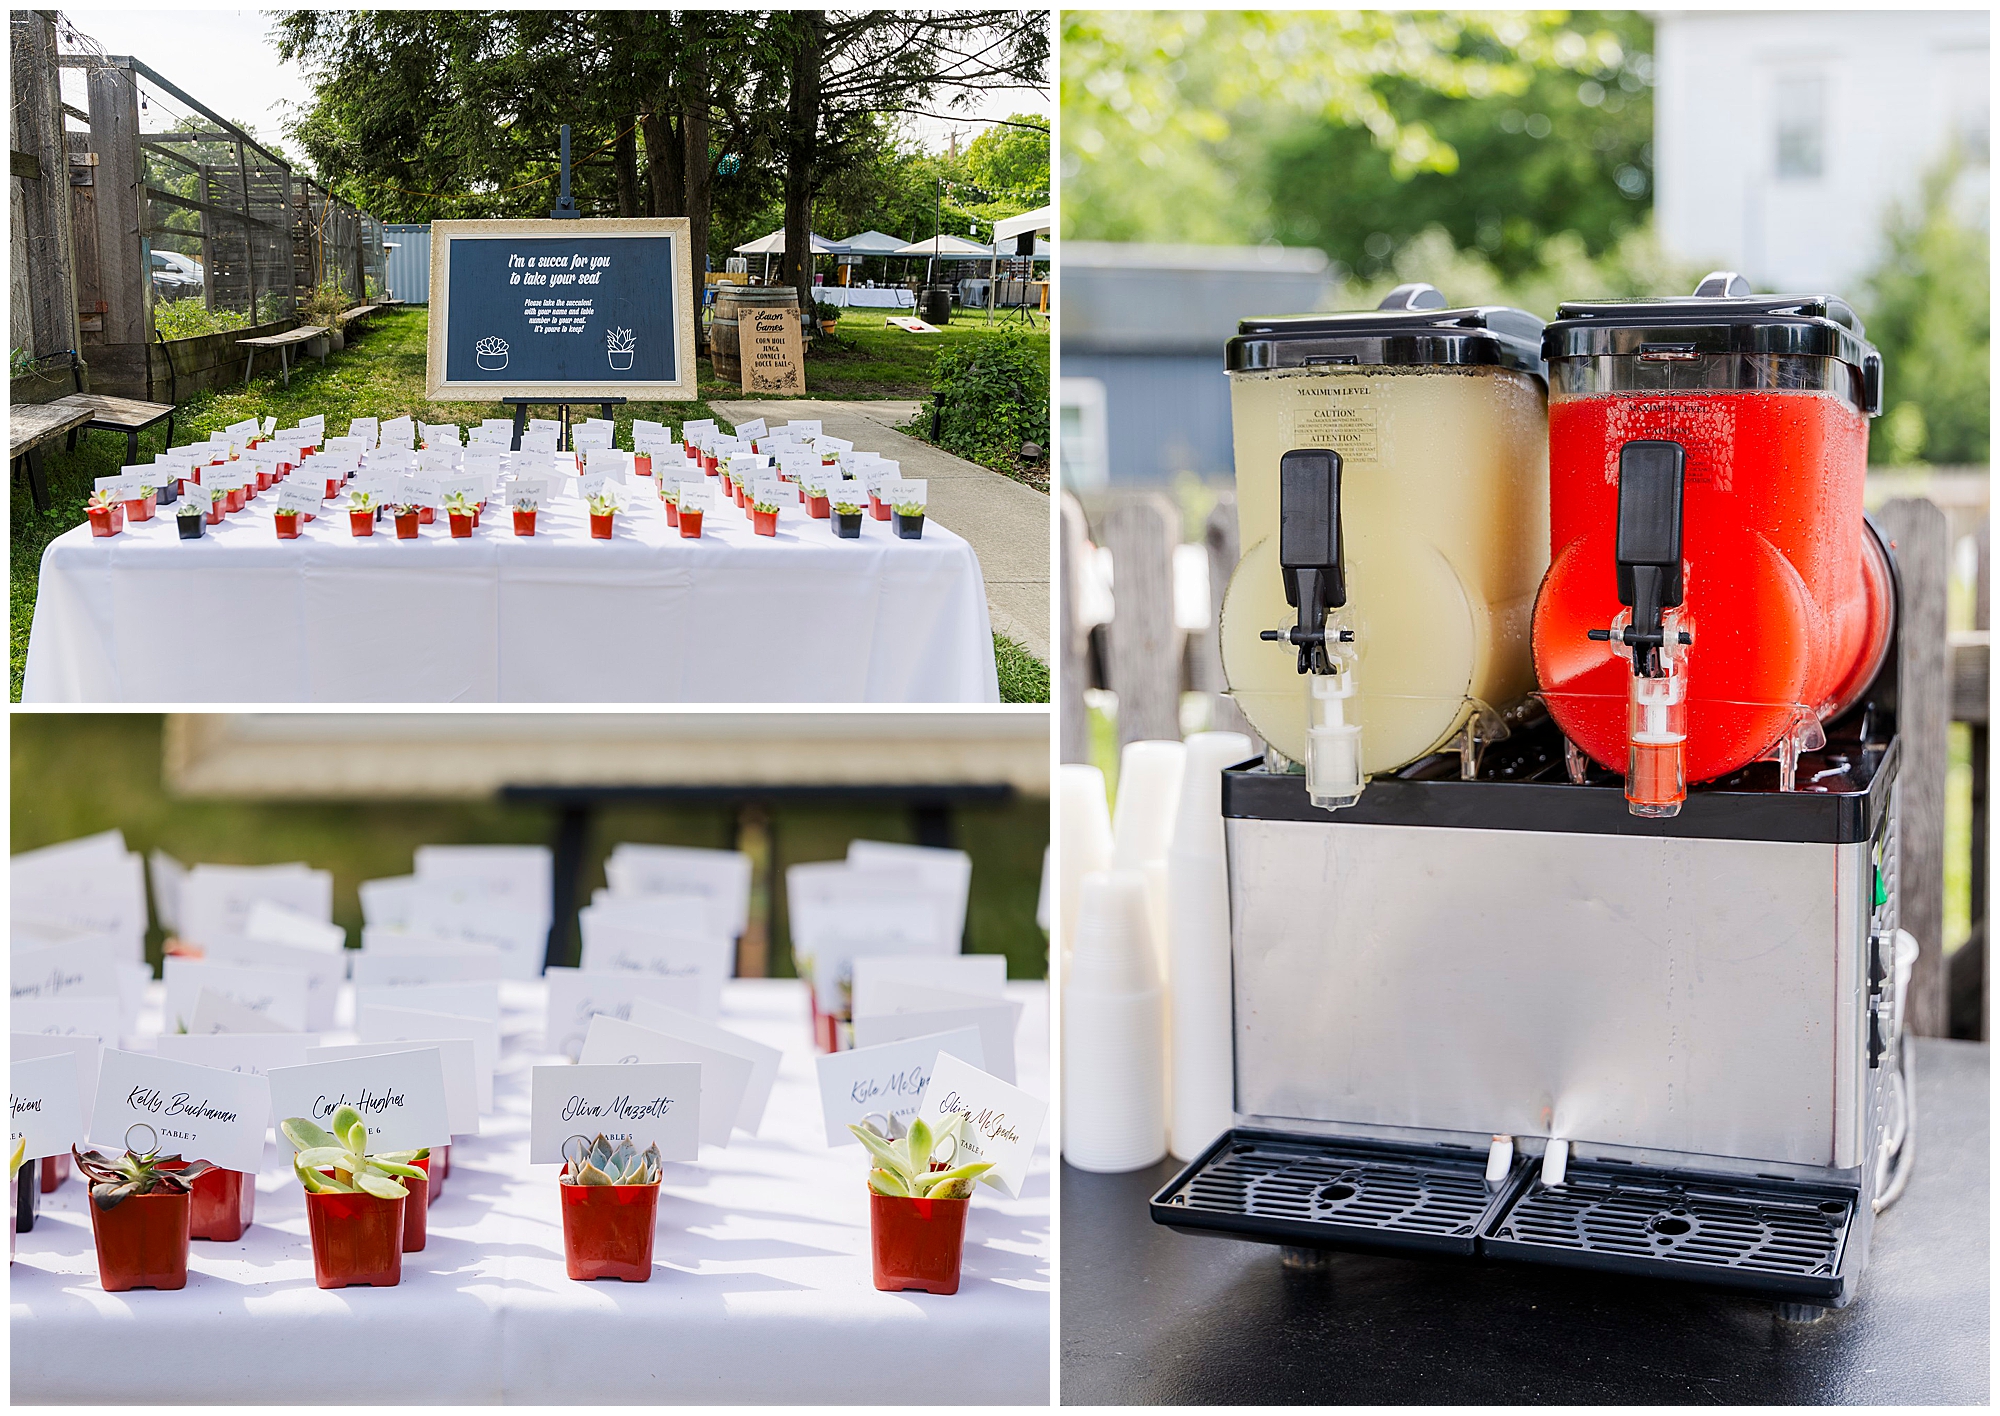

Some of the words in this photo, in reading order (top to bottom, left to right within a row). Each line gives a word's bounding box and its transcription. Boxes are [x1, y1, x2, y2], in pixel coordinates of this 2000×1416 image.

[508, 253, 525, 268] I'm
[528, 257, 536, 268] a
[538, 256, 568, 268] succa
[570, 253, 588, 270] for
[590, 256, 611, 270] you
[510, 271, 521, 285] to
[523, 271, 547, 285] take
[549, 273, 577, 288] your
[578, 271, 602, 285] seat
[524, 298, 542, 306] Please
[543, 298, 555, 306] take
[556, 298, 565, 306] the
[566, 298, 593, 306] succulent
[524, 307, 537, 315] with
[537, 308, 551, 317] your
[569, 307, 580, 315] and
[580, 307, 595, 315] table
[755, 310, 783, 320] Lawn
[529, 316, 551, 324] number
[551, 316, 558, 324] to
[558, 317, 573, 326] your
[561, 325, 568, 333] to
[568, 325, 585, 335] keep!
[756, 321, 784, 332] Games
[1297, 388, 1342, 396] MAXIMUM
[1343, 387, 1371, 395] LEVEL
[1314, 409, 1356, 418] CAUTION!
[1678, 405, 1707, 413] LEVEL
[1311, 434, 1361, 442] ATTENTION!
[851, 1079, 879, 1104] Kyle
[880, 1066, 931, 1096] McSpe
[126, 1085, 163, 1113] Kelly
[164, 1092, 238, 1122] Buchanan
[312, 1094, 351, 1119] Carl
[356, 1087, 405, 1115] Hughes
[561, 1095, 601, 1122] Oliva
[601, 1095, 675, 1120] Mazzetti
[895, 1107, 917, 1117] ABLE
[160, 1128, 189, 1140] TABLE
[960, 1139, 980, 1154] TABLE
